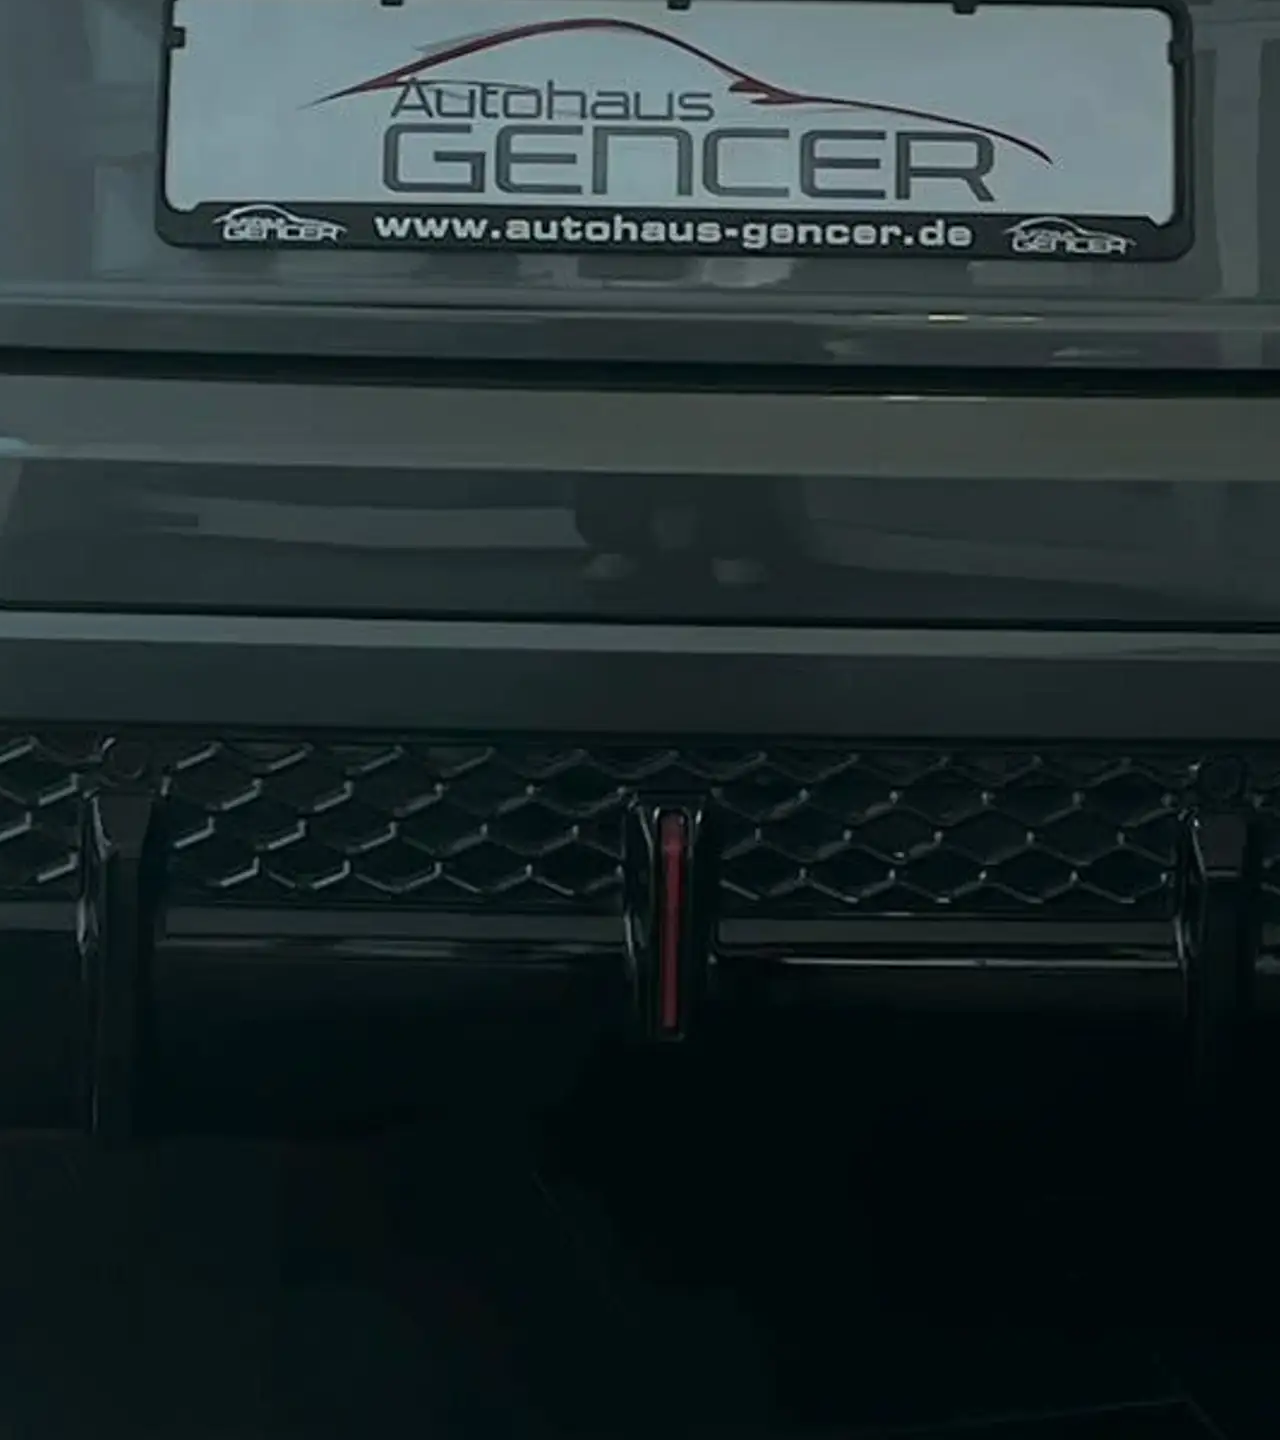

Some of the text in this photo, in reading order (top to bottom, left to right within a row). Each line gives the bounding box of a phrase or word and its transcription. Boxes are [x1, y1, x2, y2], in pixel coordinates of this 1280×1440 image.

[391, 78, 715, 121] Autohaus
[383, 123, 995, 202] GENCER
[374, 214, 973, 250] www.autohaus-gencer.de
